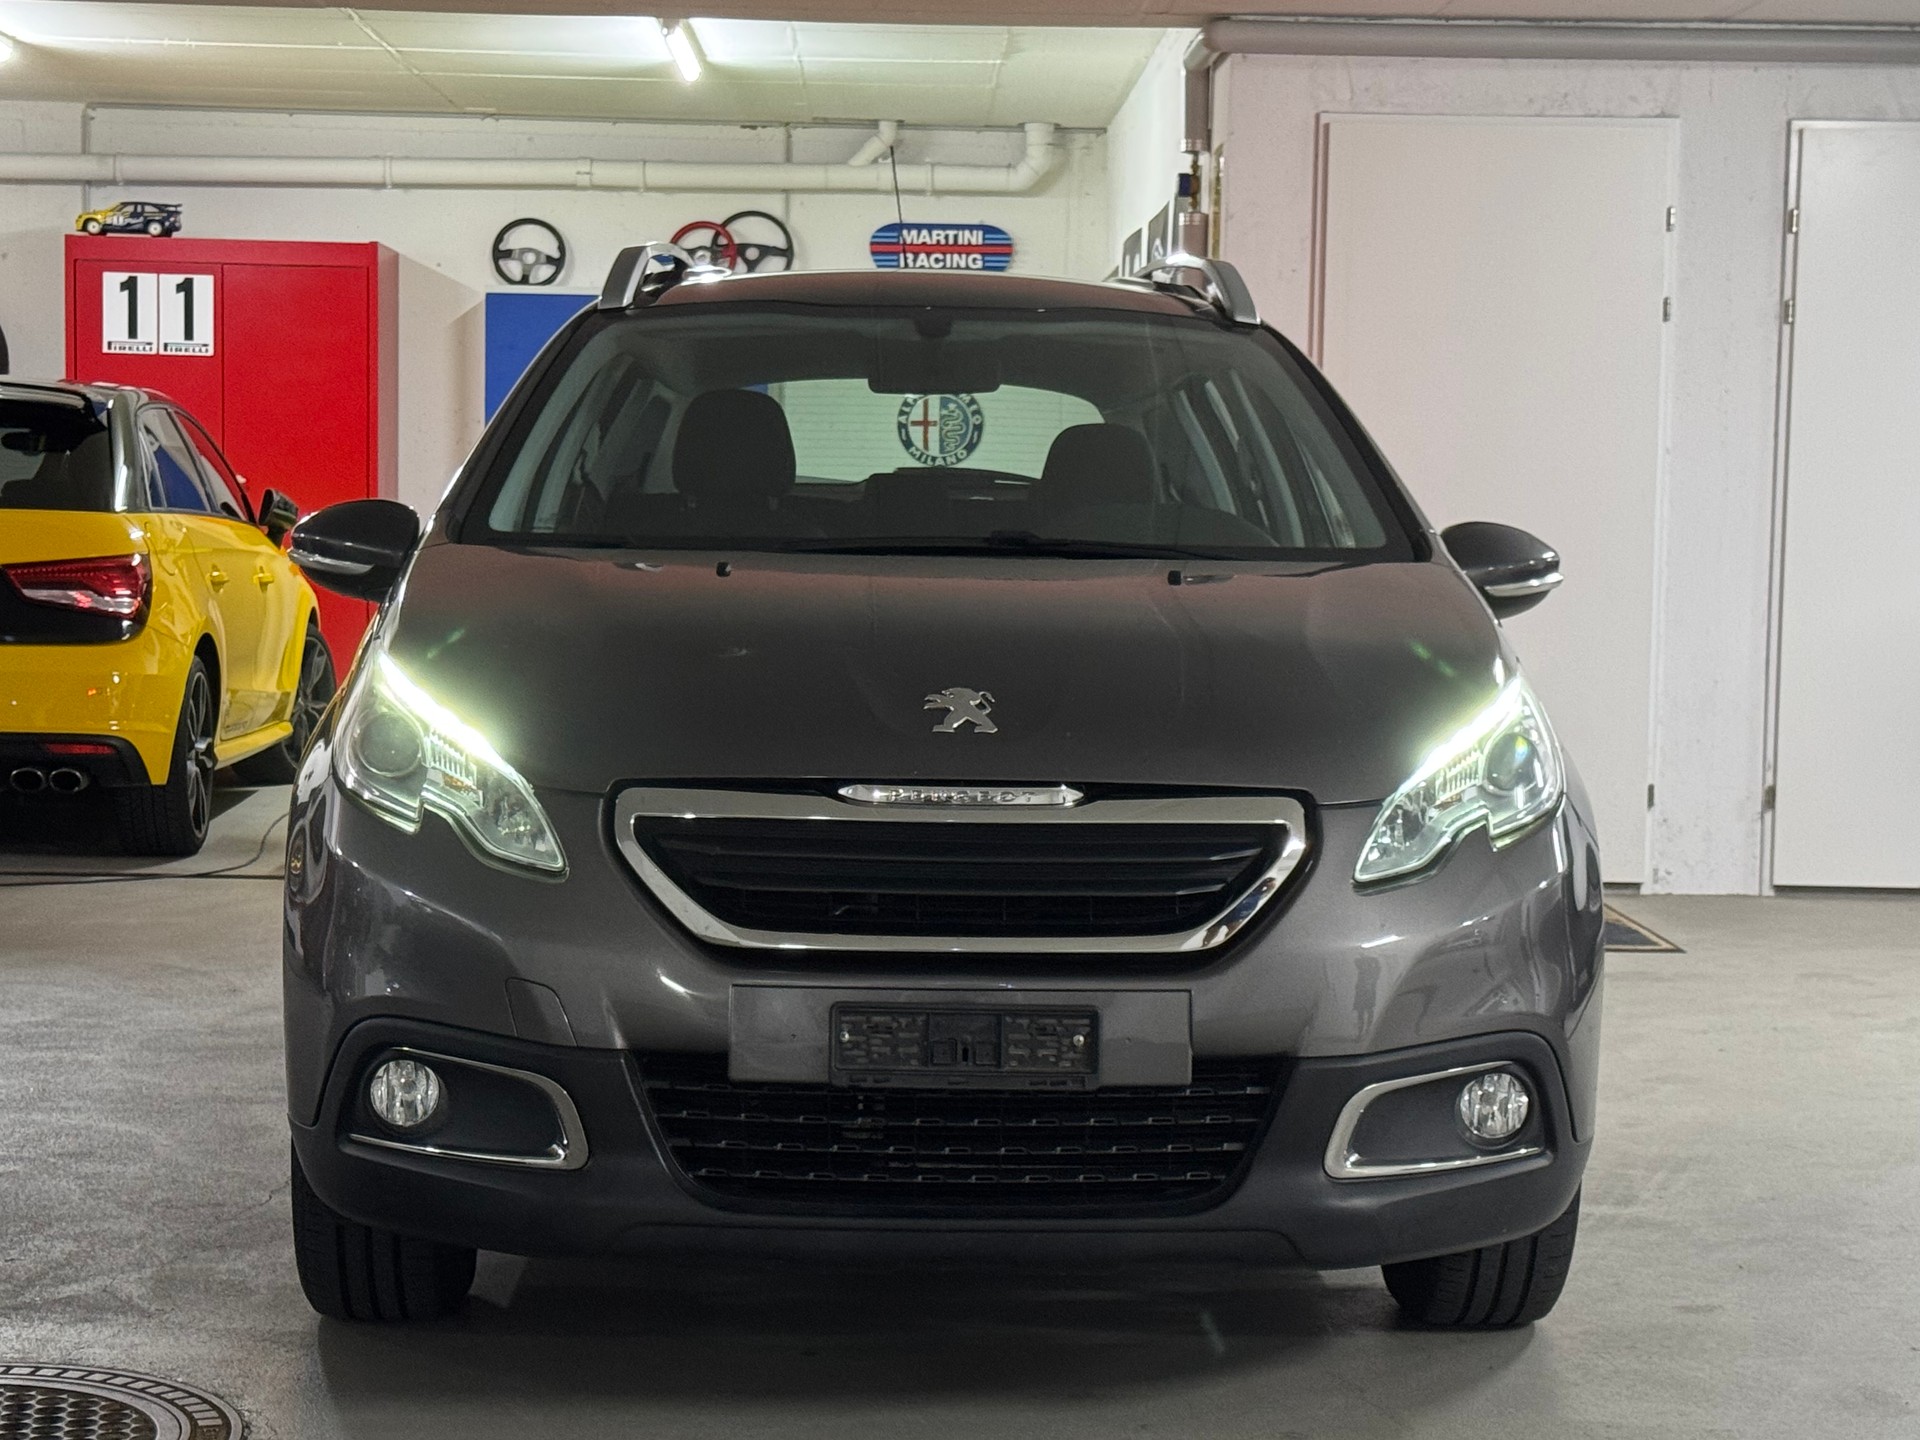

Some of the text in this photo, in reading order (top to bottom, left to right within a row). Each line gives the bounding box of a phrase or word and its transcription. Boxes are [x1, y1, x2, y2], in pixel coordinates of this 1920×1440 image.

[901, 229, 983, 245] MARTINI
[900, 252, 983, 269] RACING
[107, 341, 153, 352] PIRELLI
[163, 342, 209, 353] PIRELLI
[909, 446, 967, 466] MILANO
